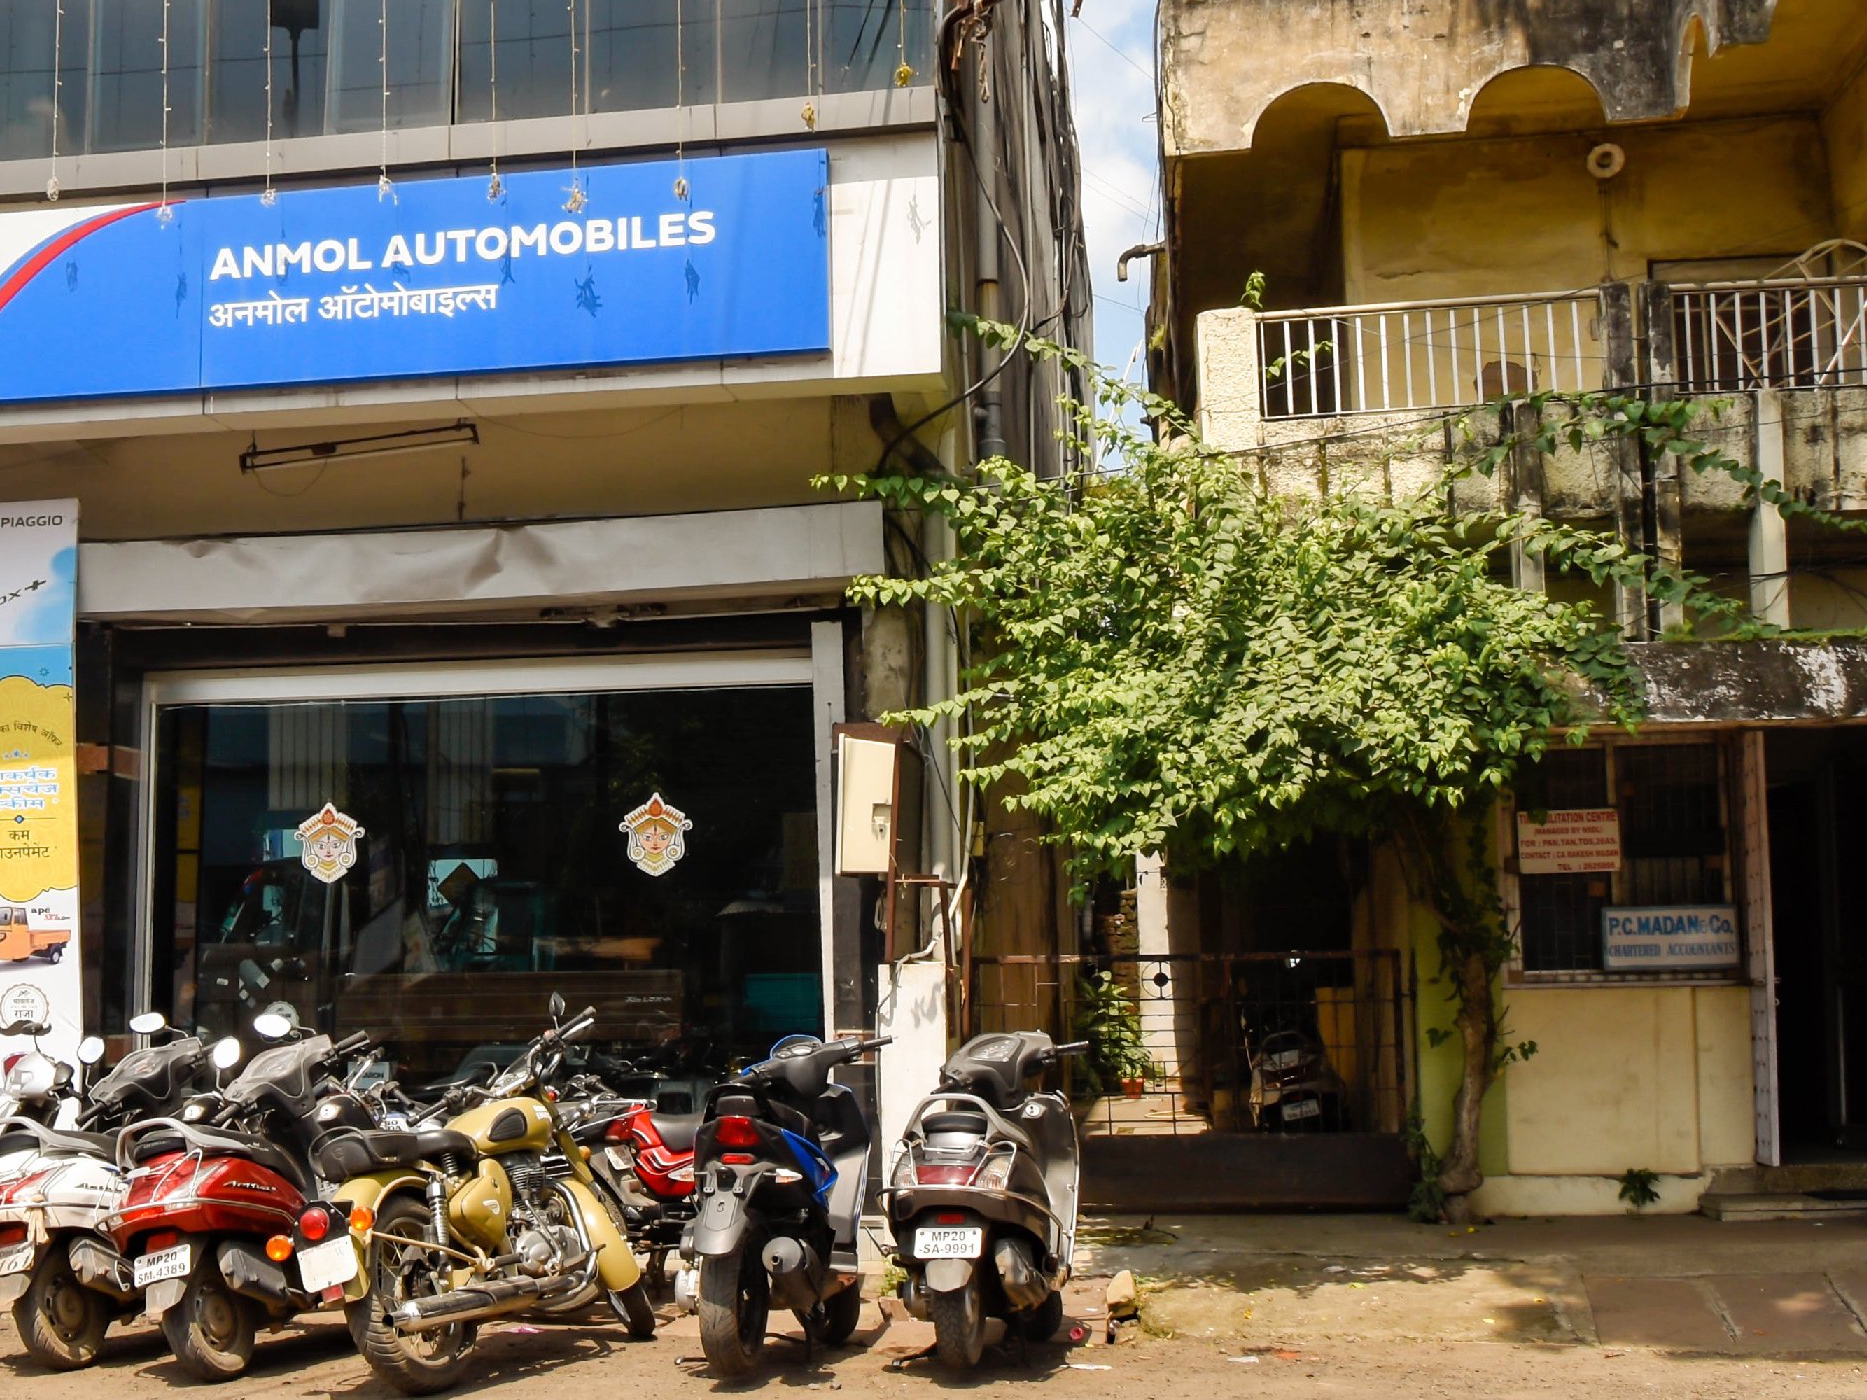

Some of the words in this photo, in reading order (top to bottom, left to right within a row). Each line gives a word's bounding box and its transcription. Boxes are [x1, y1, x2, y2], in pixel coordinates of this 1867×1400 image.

[209, 237, 372, 281] ANMOL
[381, 211, 716, 269] AUTOMOBILES
[208, 290, 309, 328] अनमोल
[317, 282, 498, 321] ऑटोमोबाइल्स
[0, 513, 64, 528] PIAGGIO
[1586, 811, 1617, 822] CENTRE
[7, 829, 30, 841] कम
[1608, 944, 1661, 958] CHARTERED
[932, 1230, 966, 1242] MP20
[146, 1251, 178, 1268] MP20
